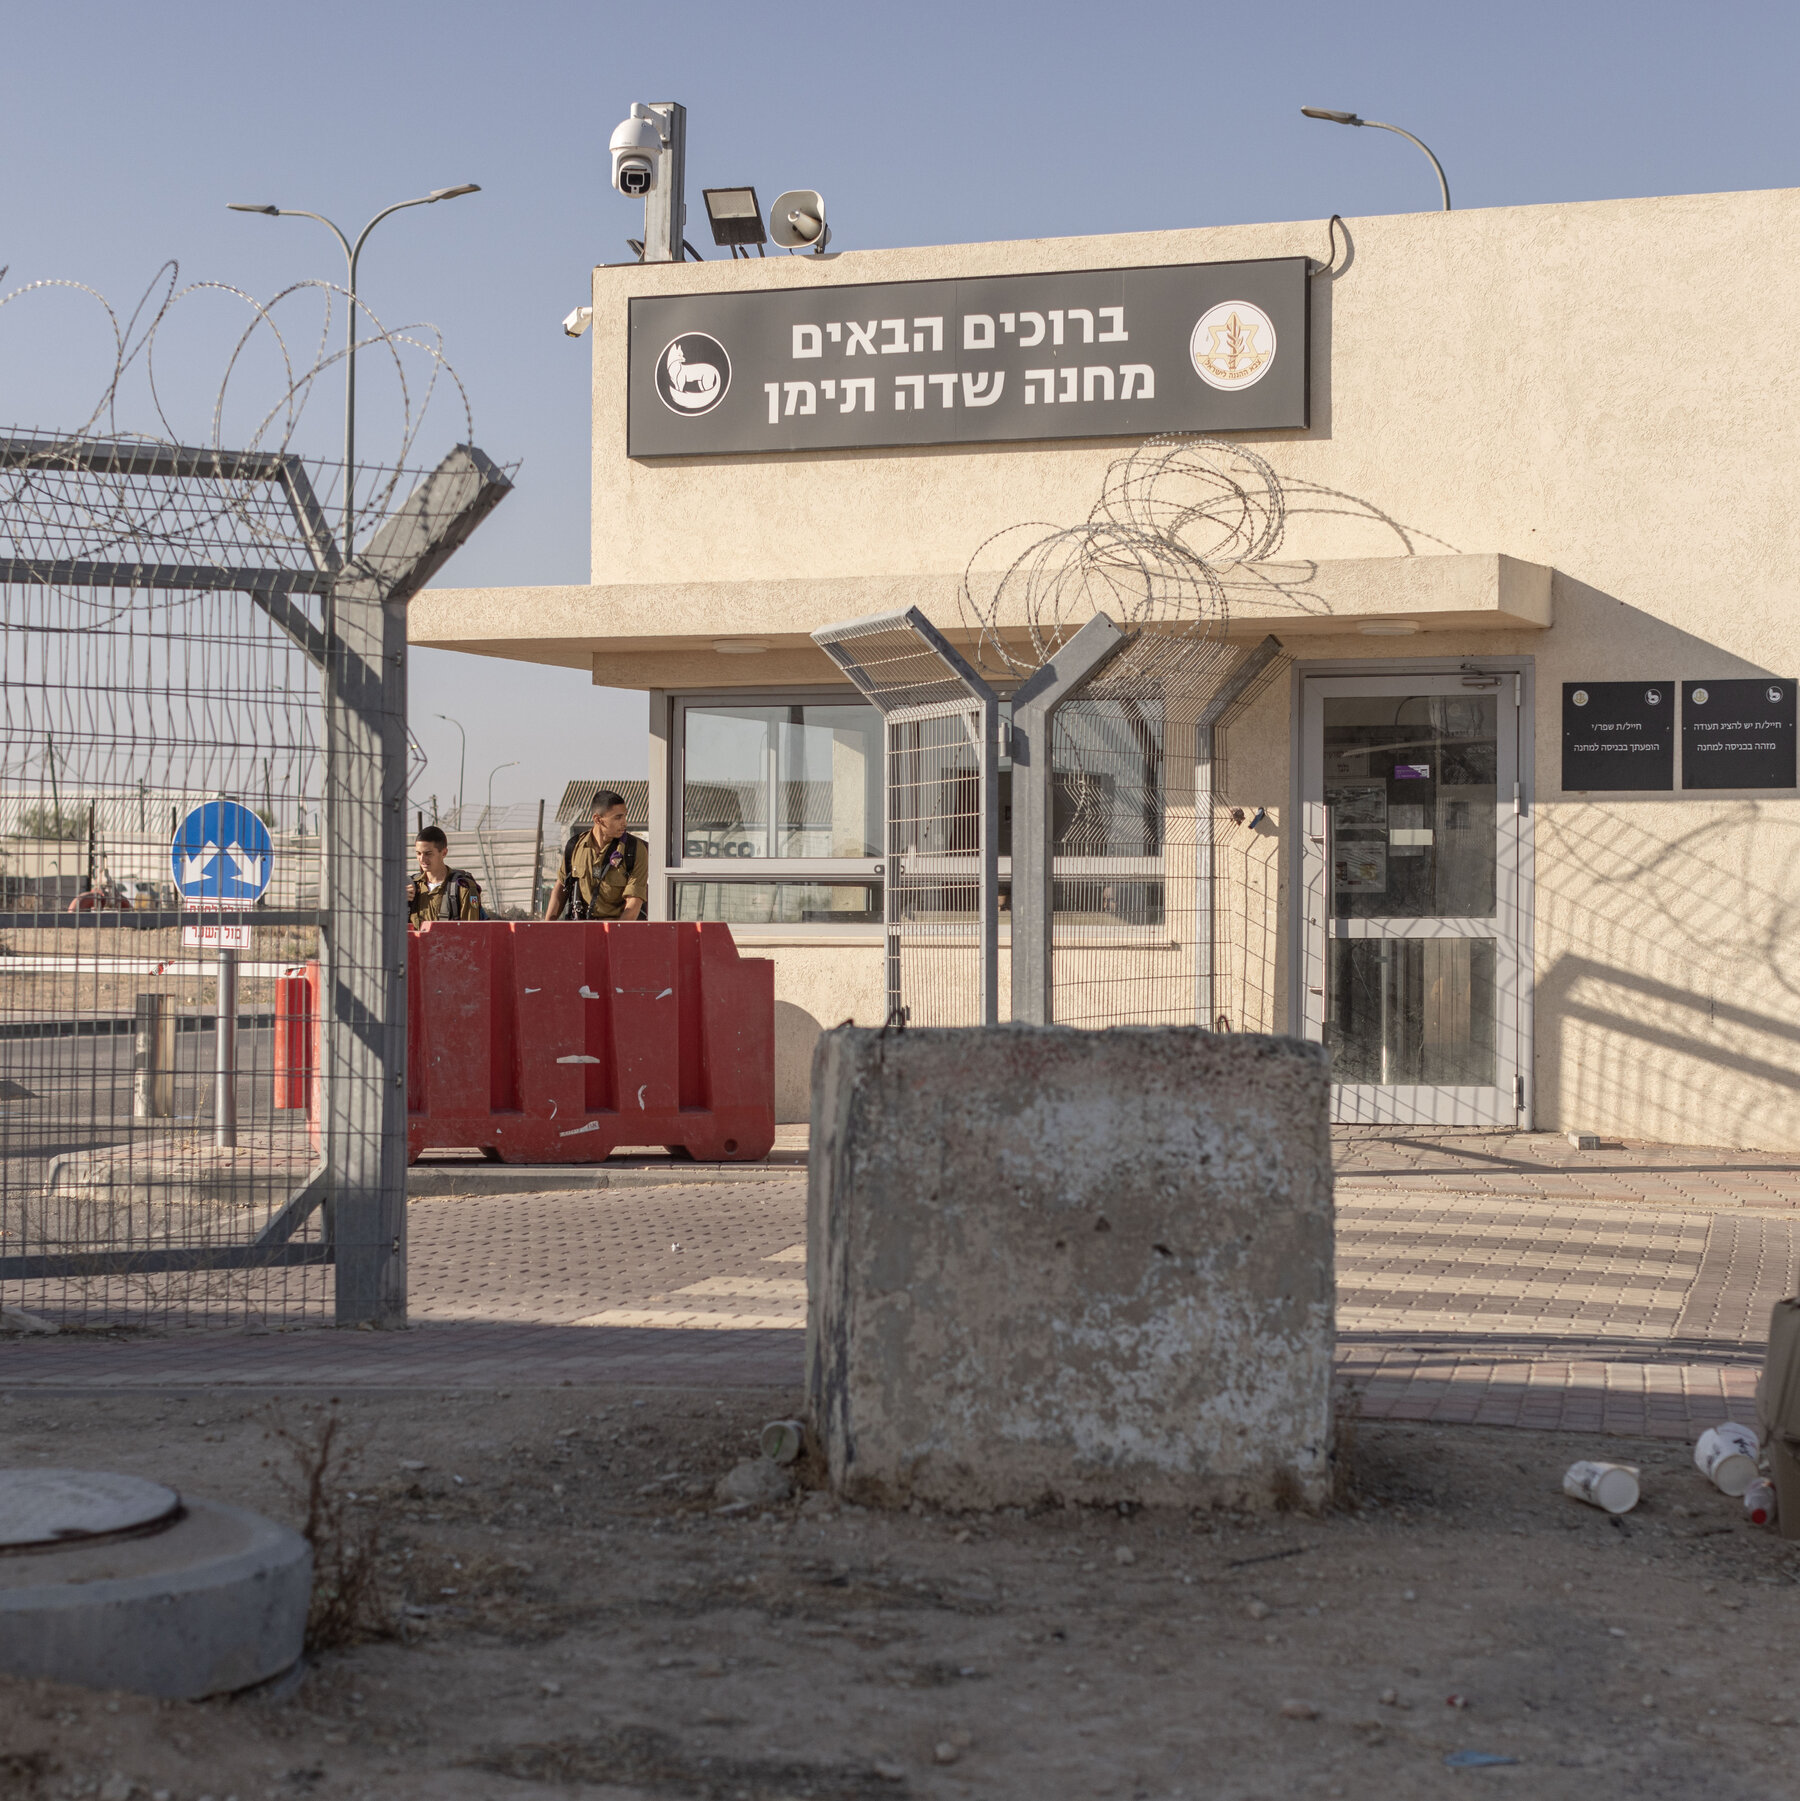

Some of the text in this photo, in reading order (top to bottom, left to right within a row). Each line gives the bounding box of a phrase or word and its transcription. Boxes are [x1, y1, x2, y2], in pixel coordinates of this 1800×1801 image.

[792, 306, 1129, 359] ברוכים הבאים
[764, 363, 1155, 424] מחנה שדה תימן
[1591, 722, 1642, 731] חייל/ת שפר/י
[1693, 720, 1782, 731] חייל/ת יש להציג תעודה
[1573, 742, 1660, 753] הופעתך בכניסה למחנה
[1697, 742, 1776, 751] מזהה בכניסה למחנה
[224, 926, 242, 940] מול
